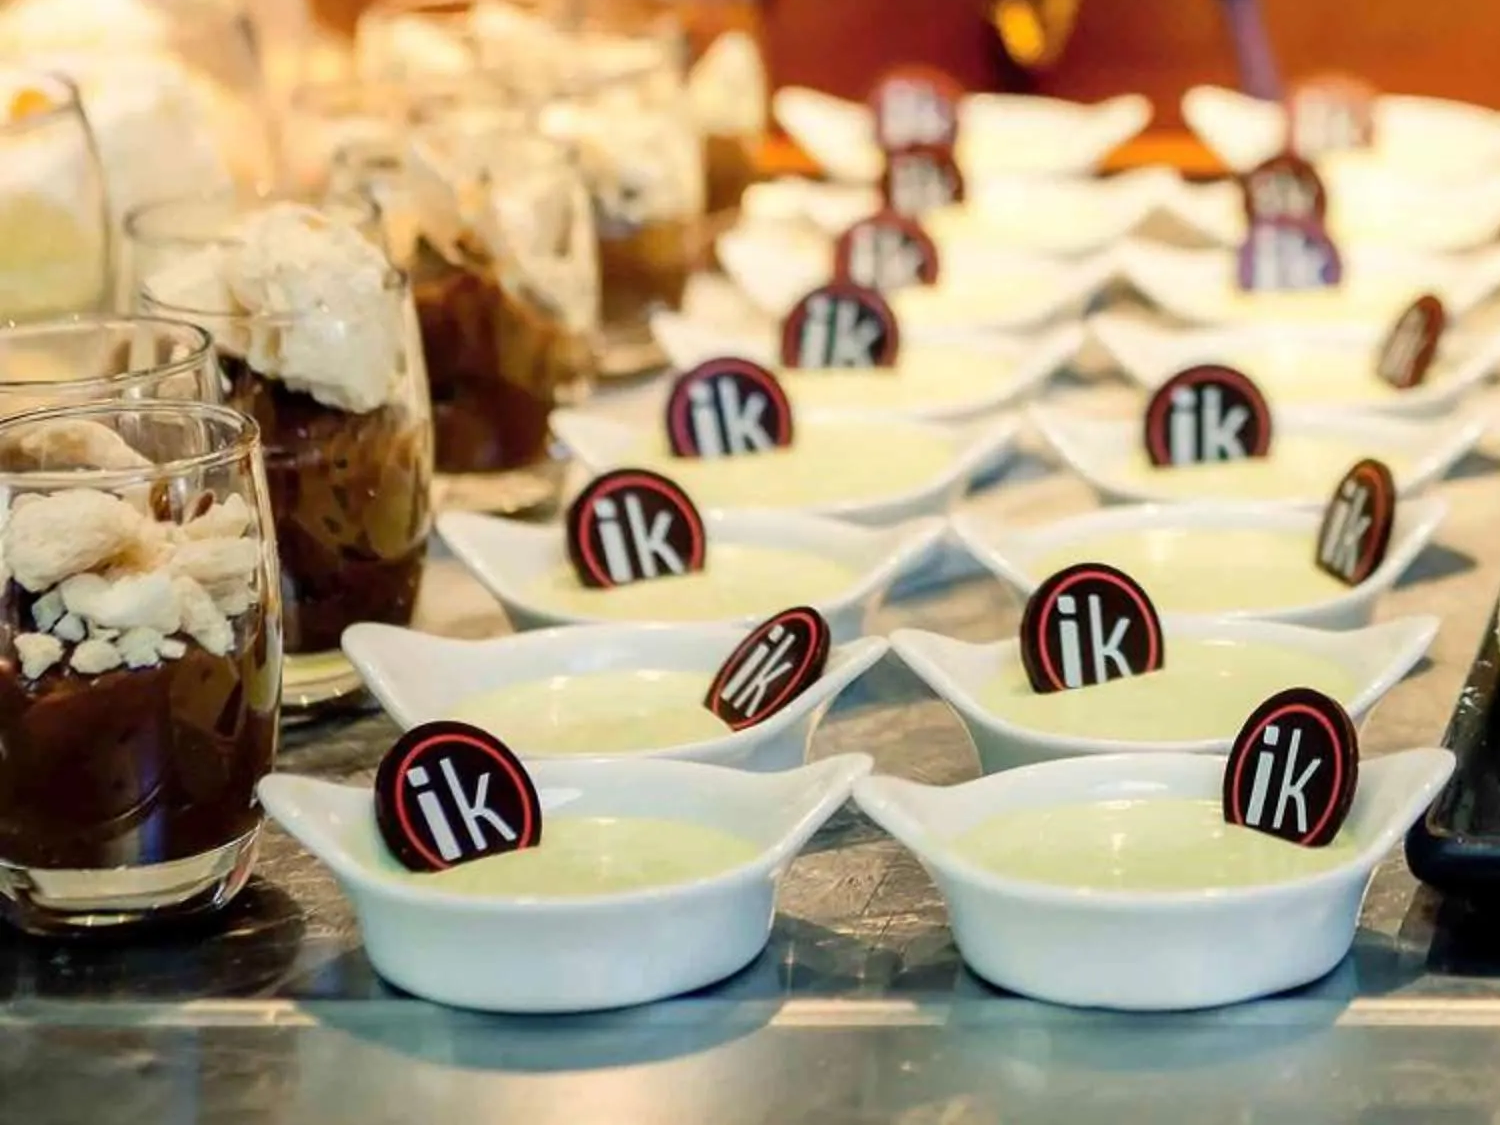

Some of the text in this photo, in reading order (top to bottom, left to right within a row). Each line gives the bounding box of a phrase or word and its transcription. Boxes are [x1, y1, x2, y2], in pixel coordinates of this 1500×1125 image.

[801, 293, 882, 368] ik
[688, 375, 777, 459] ik
[1170, 384, 1250, 466] ik
[593, 493, 686, 583] ik
[1321, 479, 1372, 579] ik
[720, 624, 795, 717] ik
[1057, 594, 1133, 688] ik
[407, 757, 517, 862] ik
[1245, 725, 1322, 833] ik
